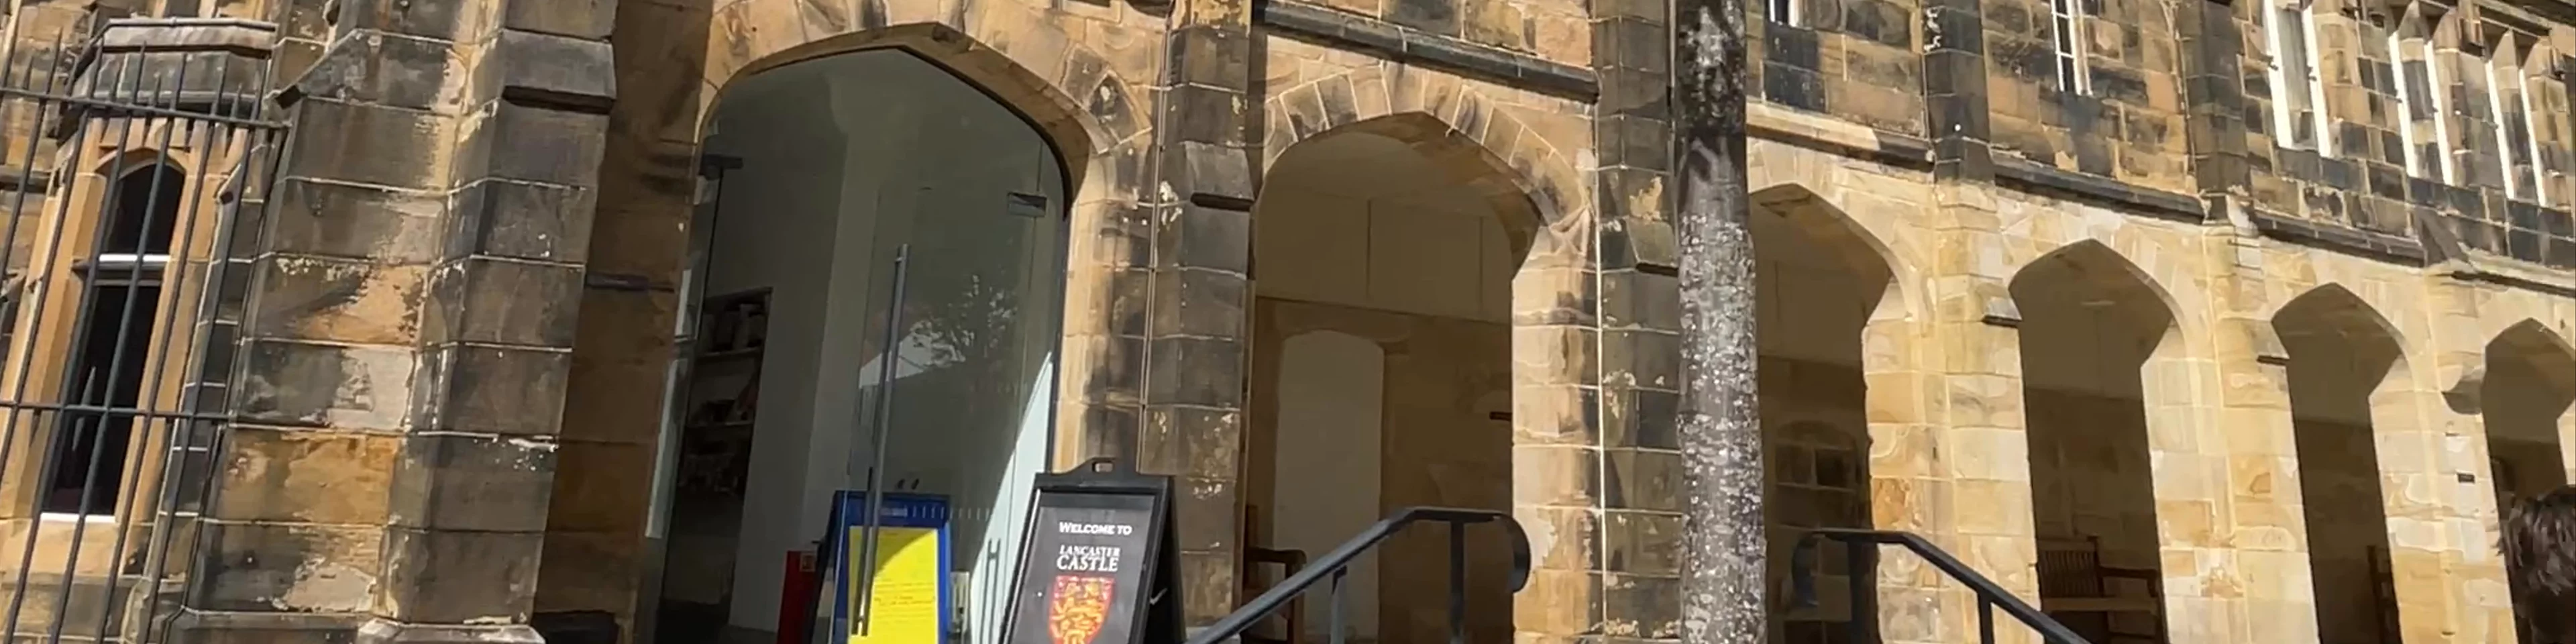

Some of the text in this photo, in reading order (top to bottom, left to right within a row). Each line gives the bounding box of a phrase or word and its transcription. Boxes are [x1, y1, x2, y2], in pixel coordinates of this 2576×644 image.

[1117, 525, 1132, 535] TO
[1060, 544, 1120, 557] LANCASTER
[1057, 554, 1119, 572] CASTLE
